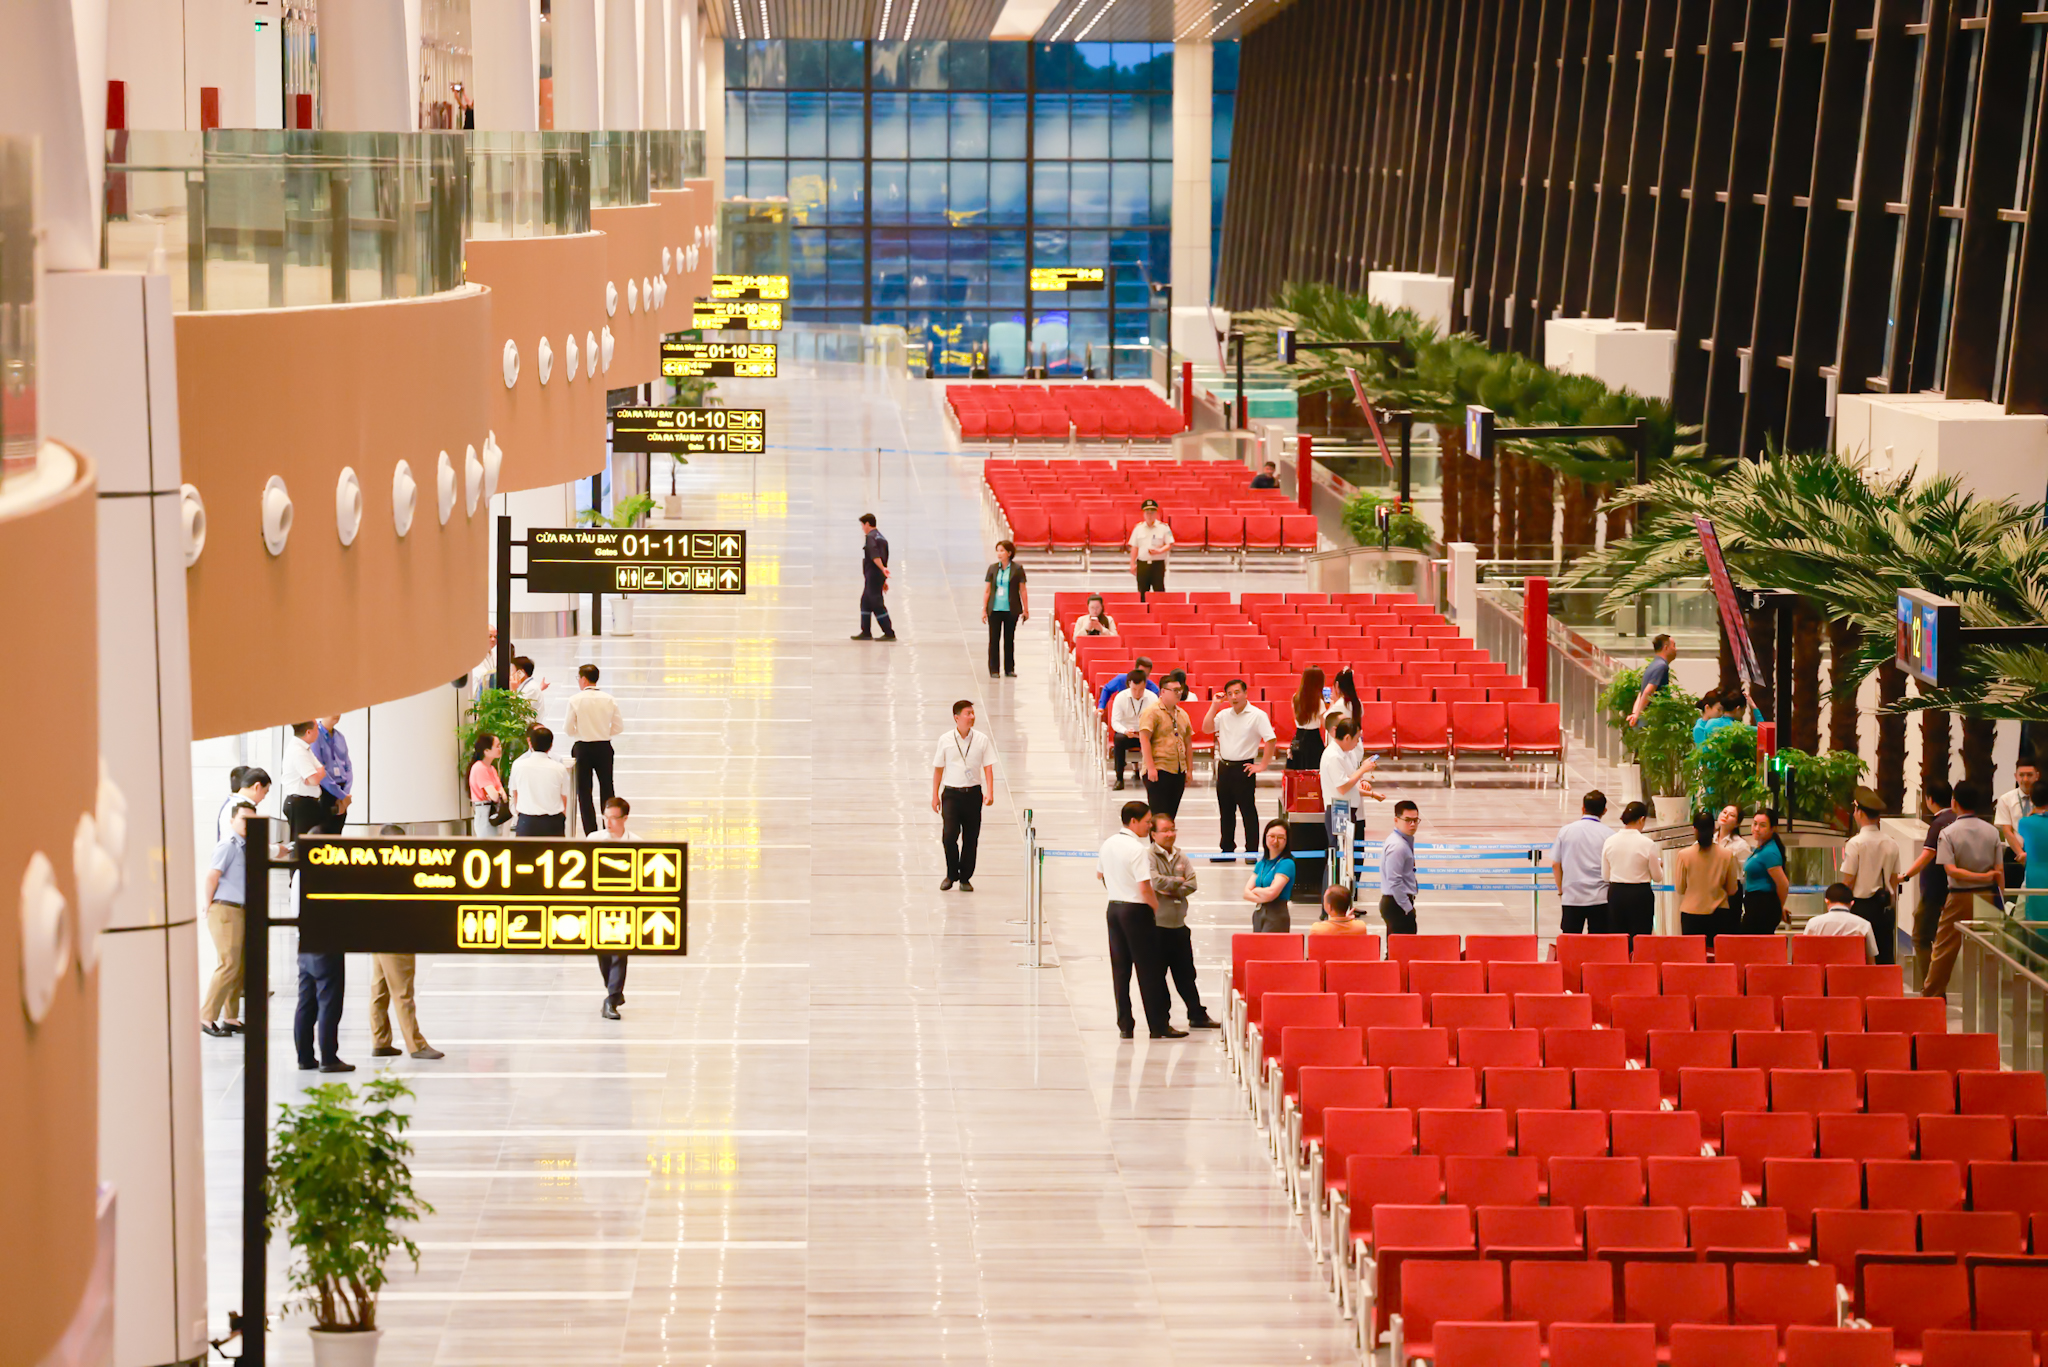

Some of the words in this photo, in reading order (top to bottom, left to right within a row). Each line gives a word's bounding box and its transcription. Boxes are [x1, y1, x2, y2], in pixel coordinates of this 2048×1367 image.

[708, 344, 748, 358] 01-10
[676, 411, 726, 428] 01-10
[707, 434, 726, 450] 11
[559, 534, 574, 543] RA
[575, 532, 595, 543] TÀU
[597, 534, 618, 543] BAY
[622, 534, 689, 556] 01-11
[594, 548, 618, 556] Gates
[1912, 616, 1921, 658] 12
[350, 848, 378, 866] RA
[379, 845, 416, 866] TÀU
[418, 848, 456, 866] BAY
[462, 848, 587, 890] 01-12
